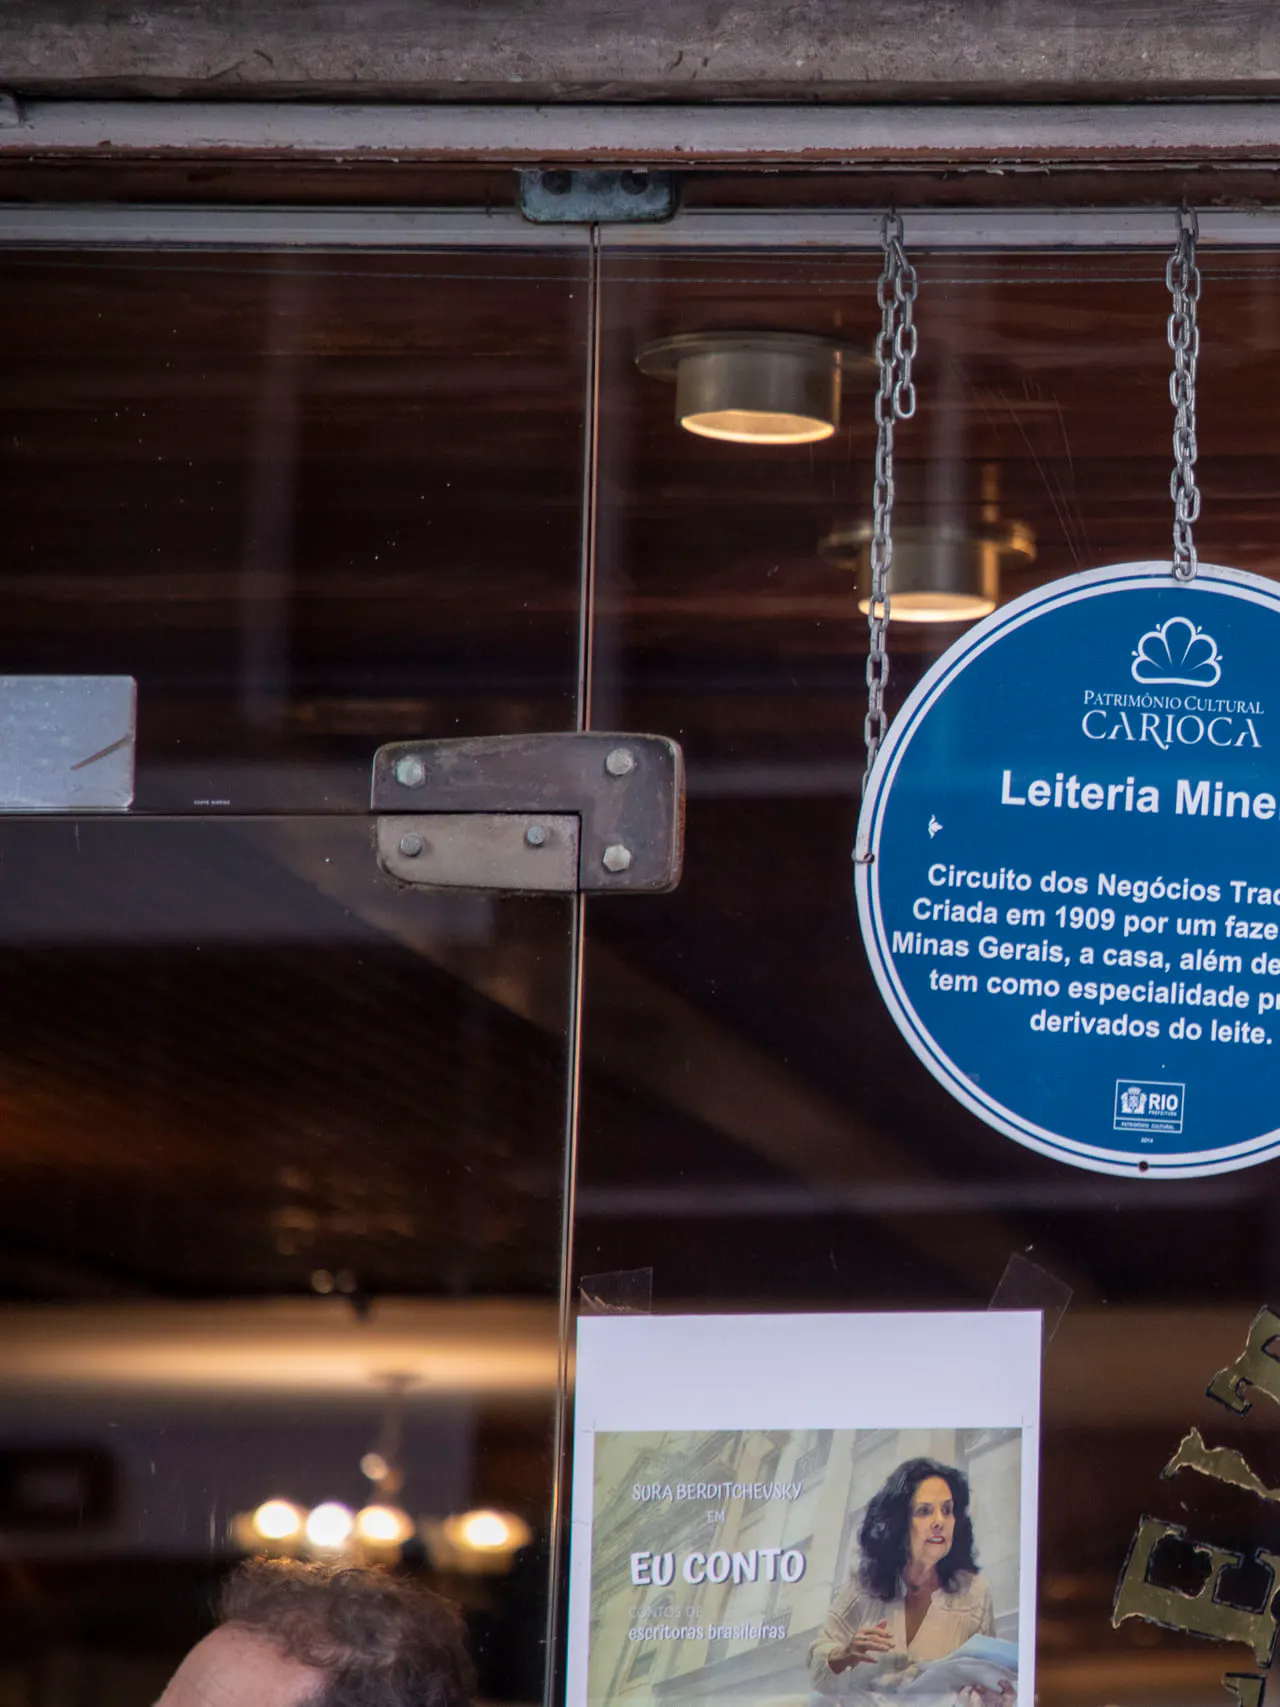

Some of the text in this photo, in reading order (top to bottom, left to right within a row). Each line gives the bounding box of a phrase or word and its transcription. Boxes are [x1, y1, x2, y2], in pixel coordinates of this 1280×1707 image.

[1084, 689, 1265, 715] PATRIMÔNIO CULTURAL
[1081, 709, 1262, 751] CARIOCA
[1001, 769, 1160, 814] Leiteria
[927, 863, 1033, 892] Circuito
[1040, 870, 1089, 895] dos
[1097, 872, 1221, 904] Negócios
[912, 897, 998, 925] Criada
[1006, 907, 1046, 927] em
[1055, 905, 1116, 931] 1909
[1123, 914, 1169, 937] por
[1176, 917, 1217, 937] um
[892, 930, 970, 958] Minas
[978, 935, 1071, 967] Gerais,
[1079, 946, 1095, 965] a
[1102, 948, 1171, 973] casa,
[1179, 948, 1243, 973] além
[929, 968, 979, 993] tem
[986, 976, 1061, 998] como
[1068, 980, 1250, 1009] especialidade
[1029, 1008, 1273, 1045] derivados do leite.
[1148, 1092, 1178, 1112] RIO
[632, 1481, 802, 1501] SURA BERDITCHEVSKY
[707, 1510, 725, 1523] EM
[630, 1549, 807, 1587] EU CONTO
[628, 1623, 786, 1641] escritoras brasileiras
